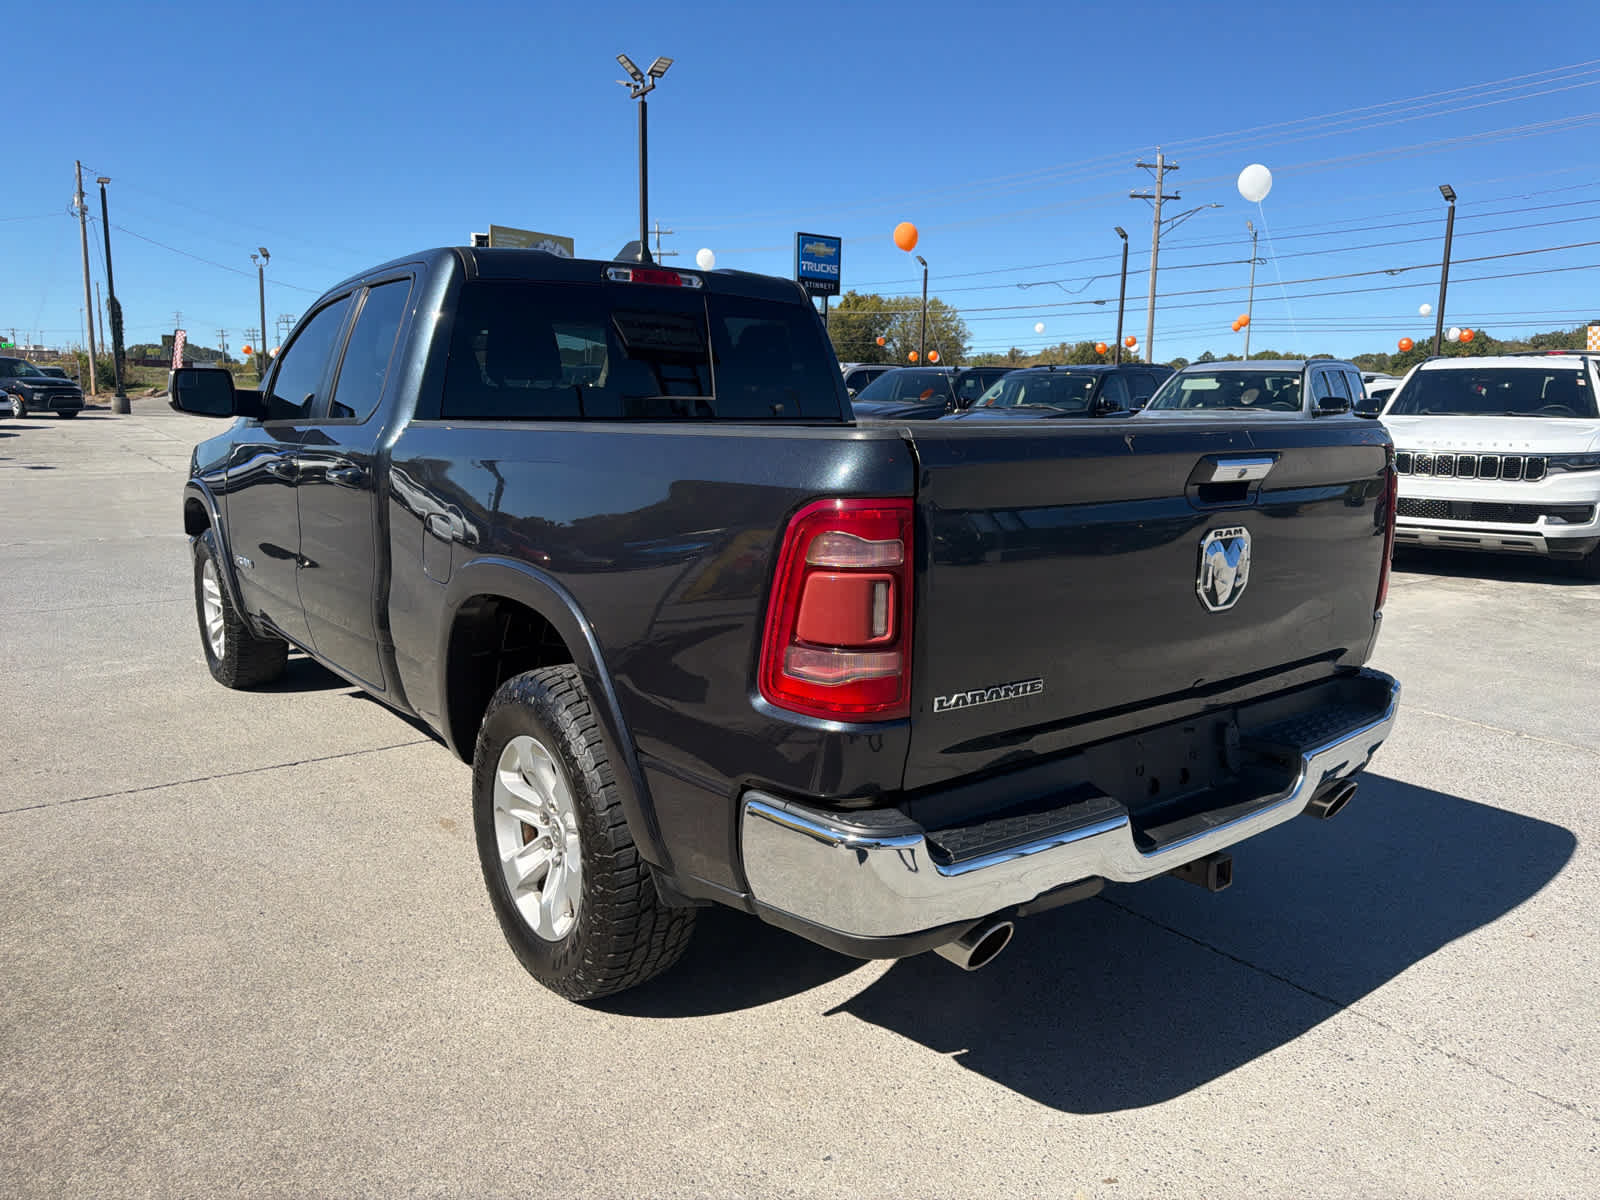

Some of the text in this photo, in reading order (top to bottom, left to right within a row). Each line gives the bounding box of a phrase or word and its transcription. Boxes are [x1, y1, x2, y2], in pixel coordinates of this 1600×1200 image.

[801, 261, 838, 274] TRUCKS
[1213, 528, 1243, 538] RAM
[934, 679, 1043, 712] LARAMIE
